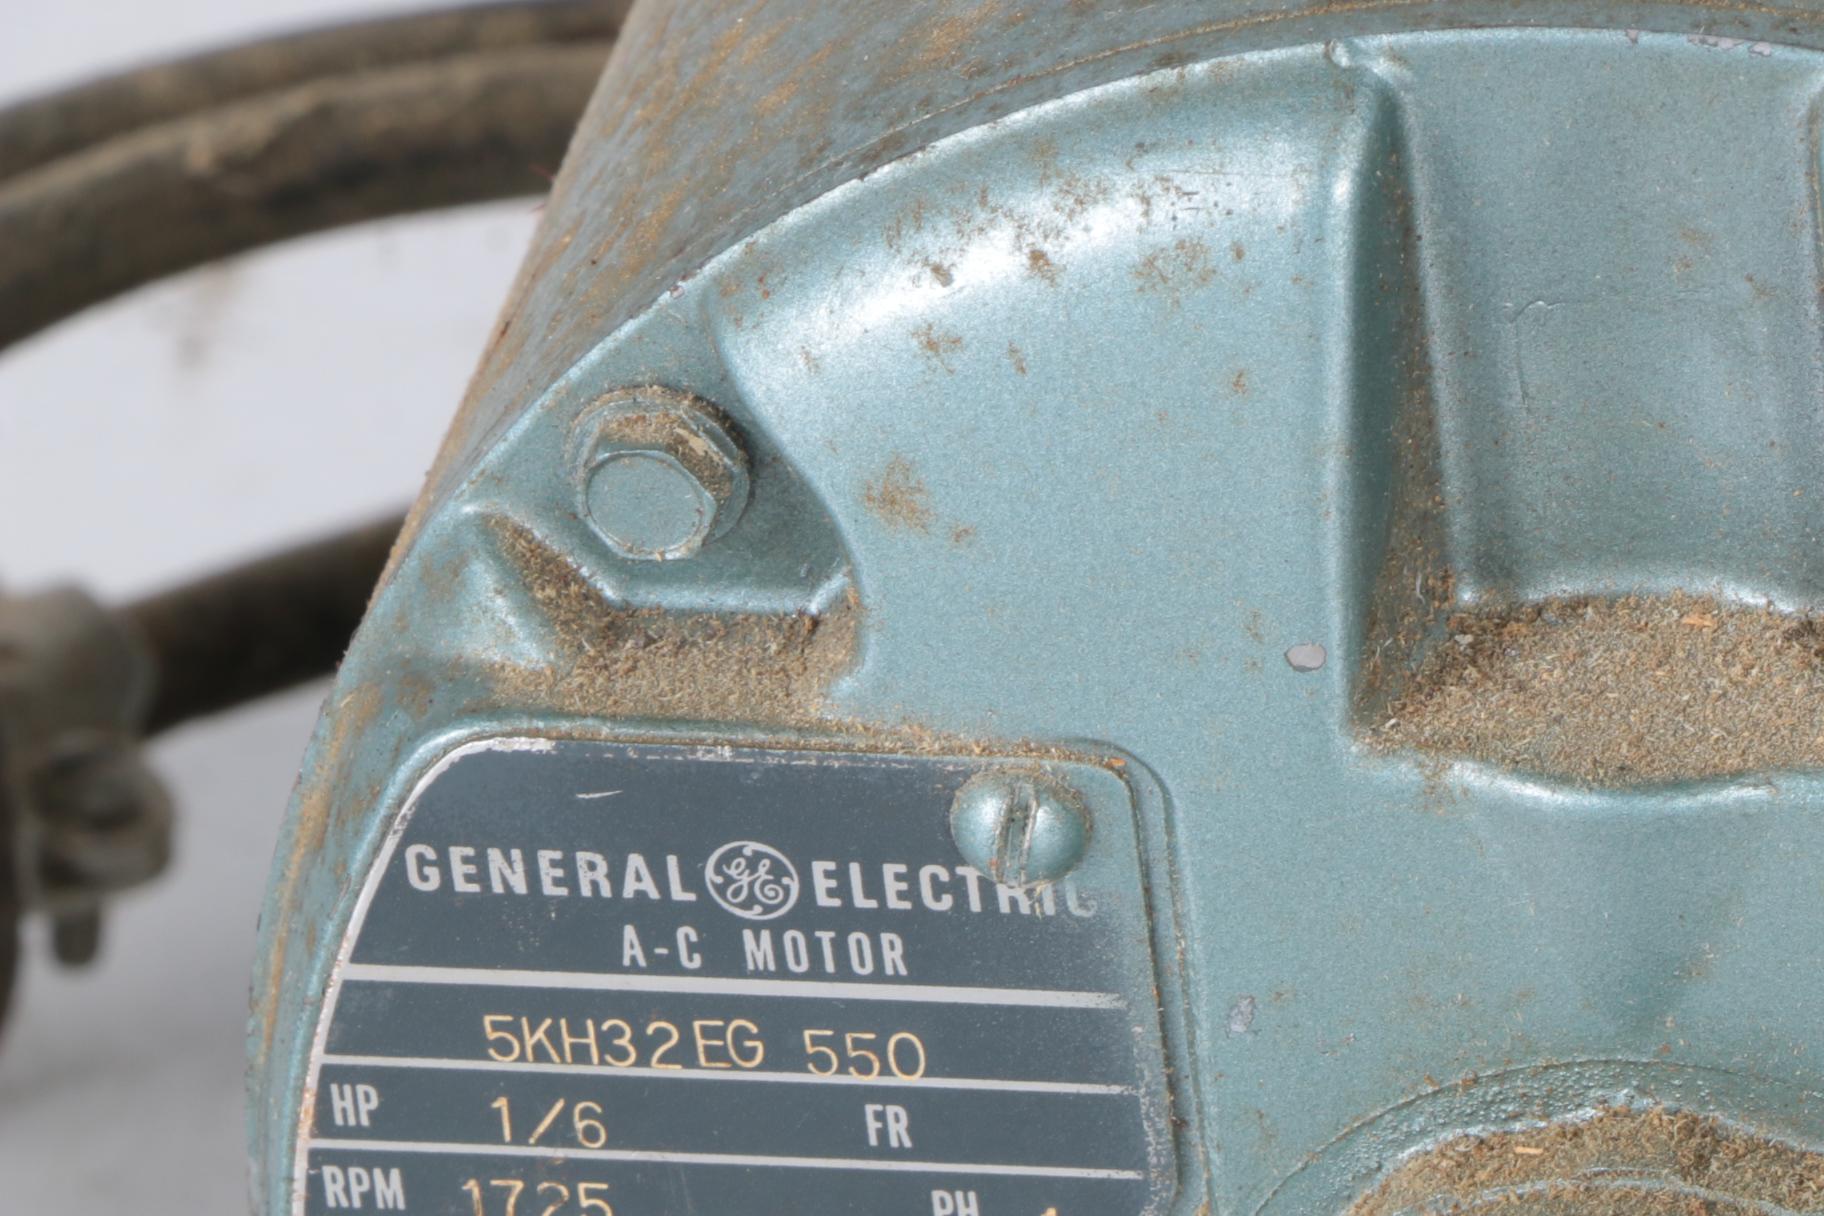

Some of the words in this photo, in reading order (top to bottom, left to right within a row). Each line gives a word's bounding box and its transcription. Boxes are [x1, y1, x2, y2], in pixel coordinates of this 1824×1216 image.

[405, 844, 697, 902] GENERAL
[621, 924, 702, 969] A-C
[744, 929, 908, 976] MOTOR
[482, 1014, 765, 1071] 5KH32EG
[803, 1029, 927, 1081] 550
[331, 1083, 379, 1128] HP
[490, 1096, 608, 1149] 1/6
[865, 1104, 913, 1149] FR
[322, 1165, 406, 1211] RPM
